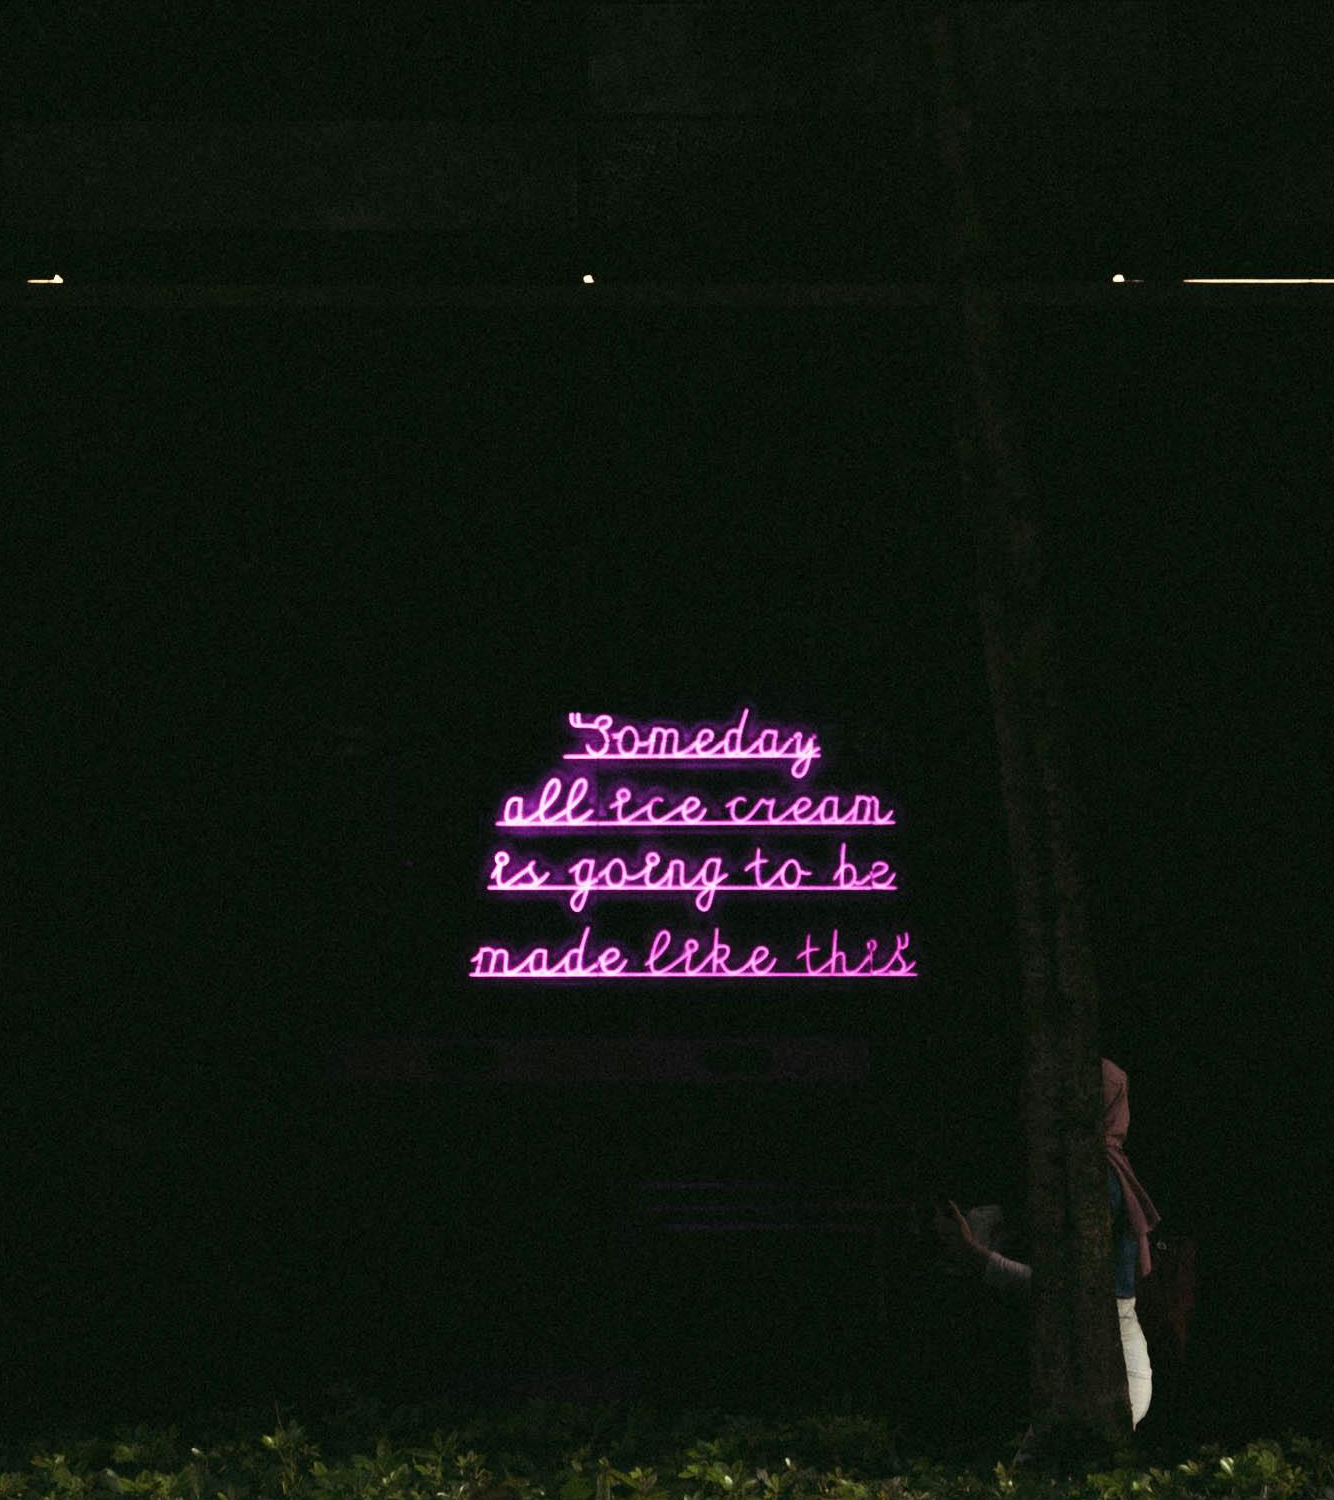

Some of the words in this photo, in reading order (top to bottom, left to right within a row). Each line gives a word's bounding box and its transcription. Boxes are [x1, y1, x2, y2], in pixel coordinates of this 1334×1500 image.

[503, 777, 594, 824] all
[609, 787, 707, 824] ice
[726, 795, 895, 824] cream
[490, 851, 550, 889] is
[569, 851, 728, 912] going
[745, 847, 812, 889] to
[834, 843, 897, 889] be
[470, 926, 628, 976] made
[645, 929, 777, 976] like
